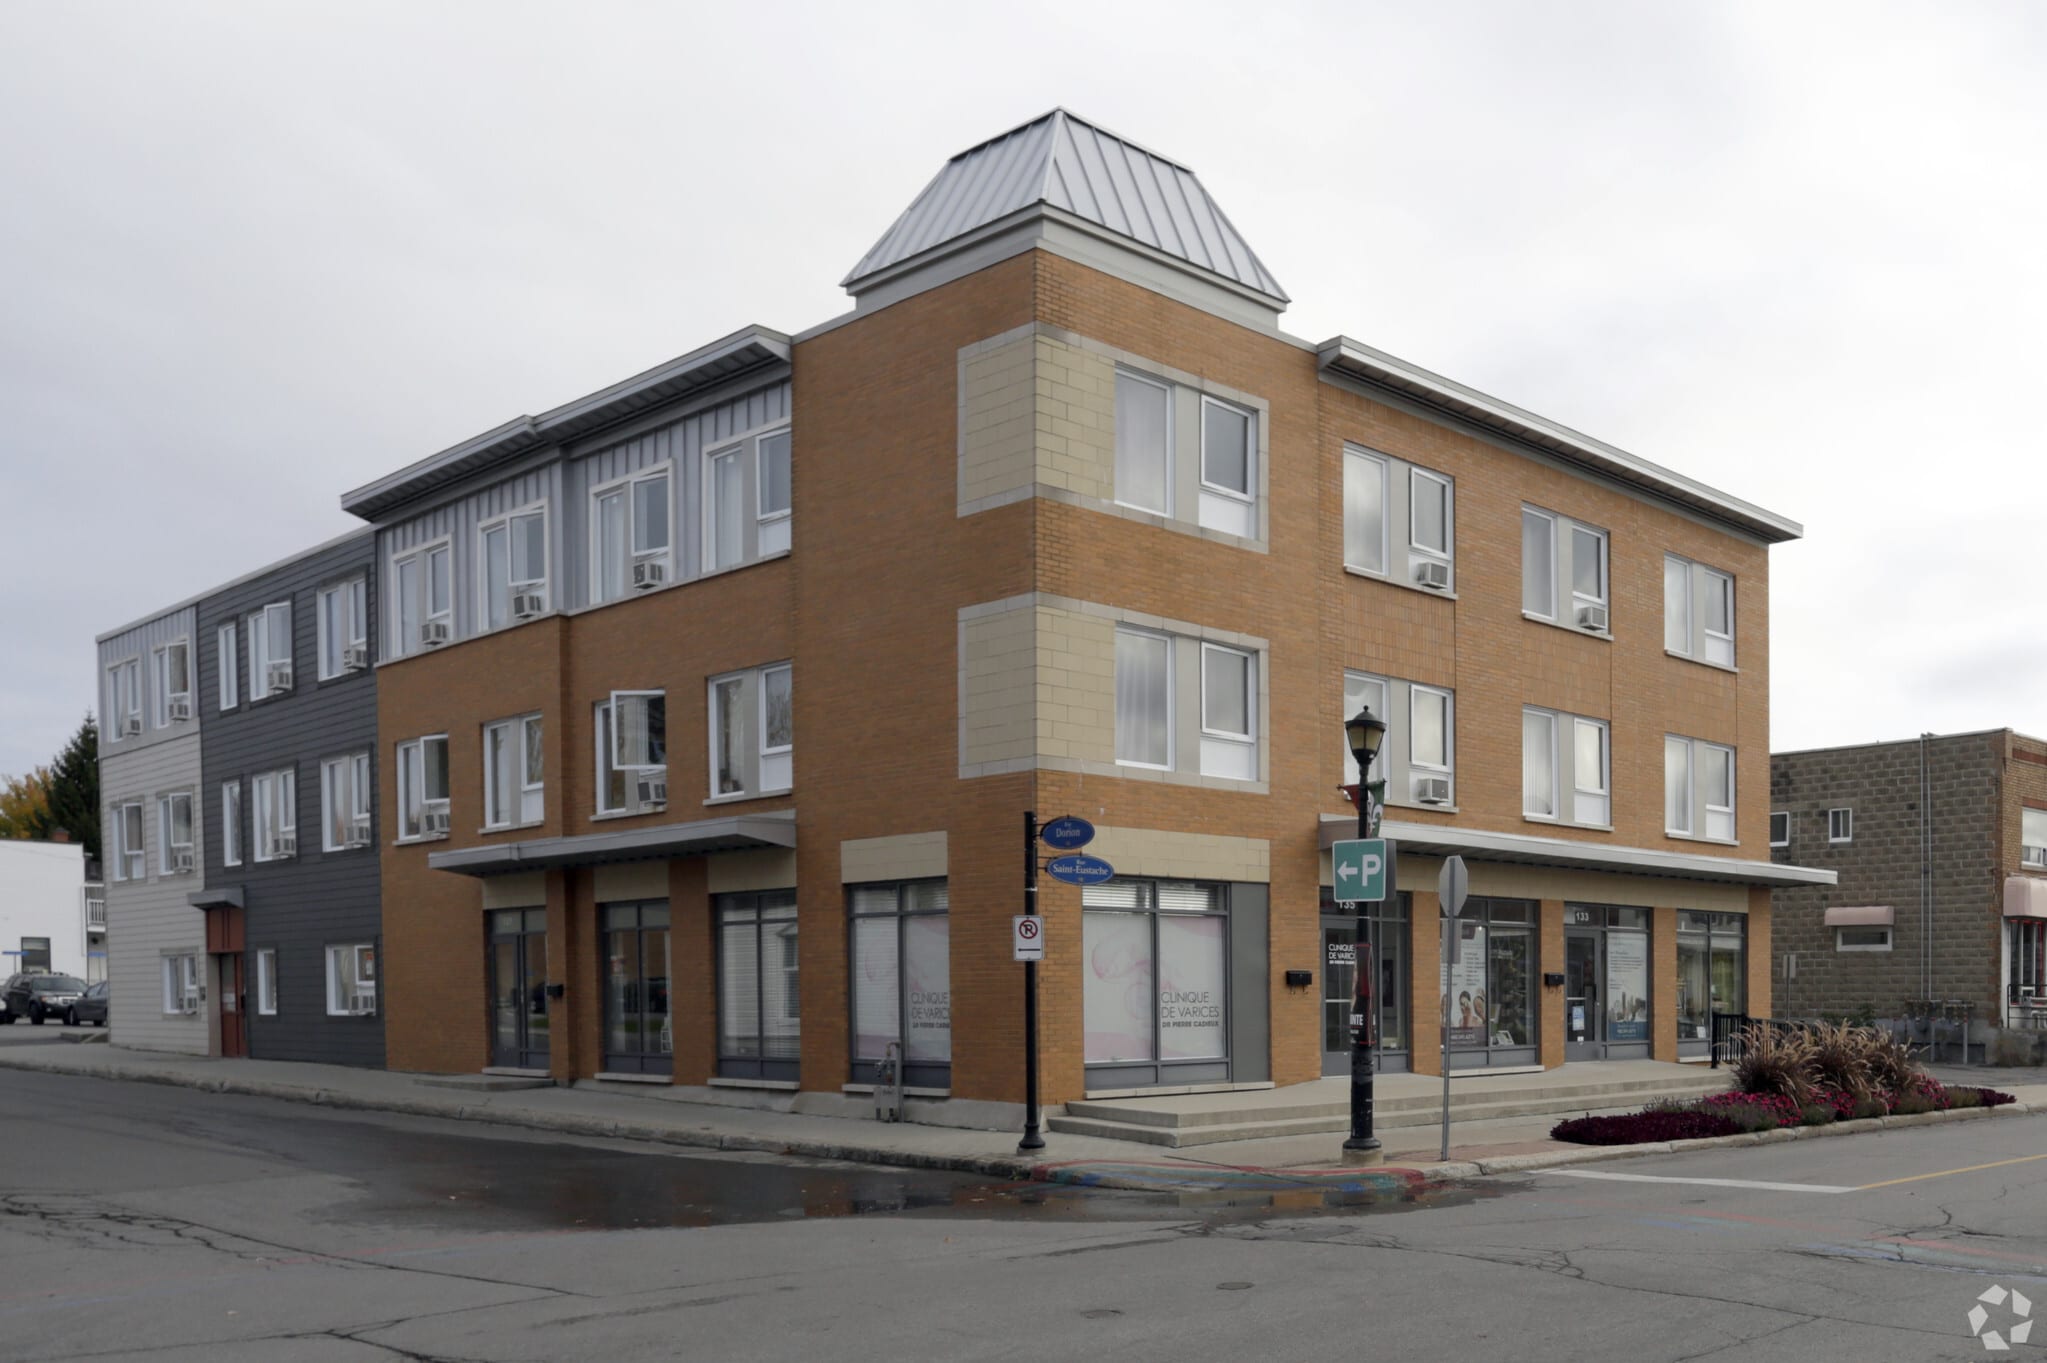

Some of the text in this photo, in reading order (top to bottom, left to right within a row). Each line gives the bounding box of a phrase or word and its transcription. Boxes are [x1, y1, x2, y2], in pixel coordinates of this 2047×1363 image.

[1053, 864, 1109, 875] Saint-Eustache
[1361, 853, 1382, 887] P
[1339, 900, 1356, 909] 135
[1575, 911, 1590, 921] 133
[1328, 951, 1337, 960] DE
[911, 991, 949, 1004] CLINIQUE
[1160, 991, 1209, 1004] CLINIQUE
[912, 1007, 922, 1019] DE
[1161, 1006, 1220, 1018] DE VARICES
